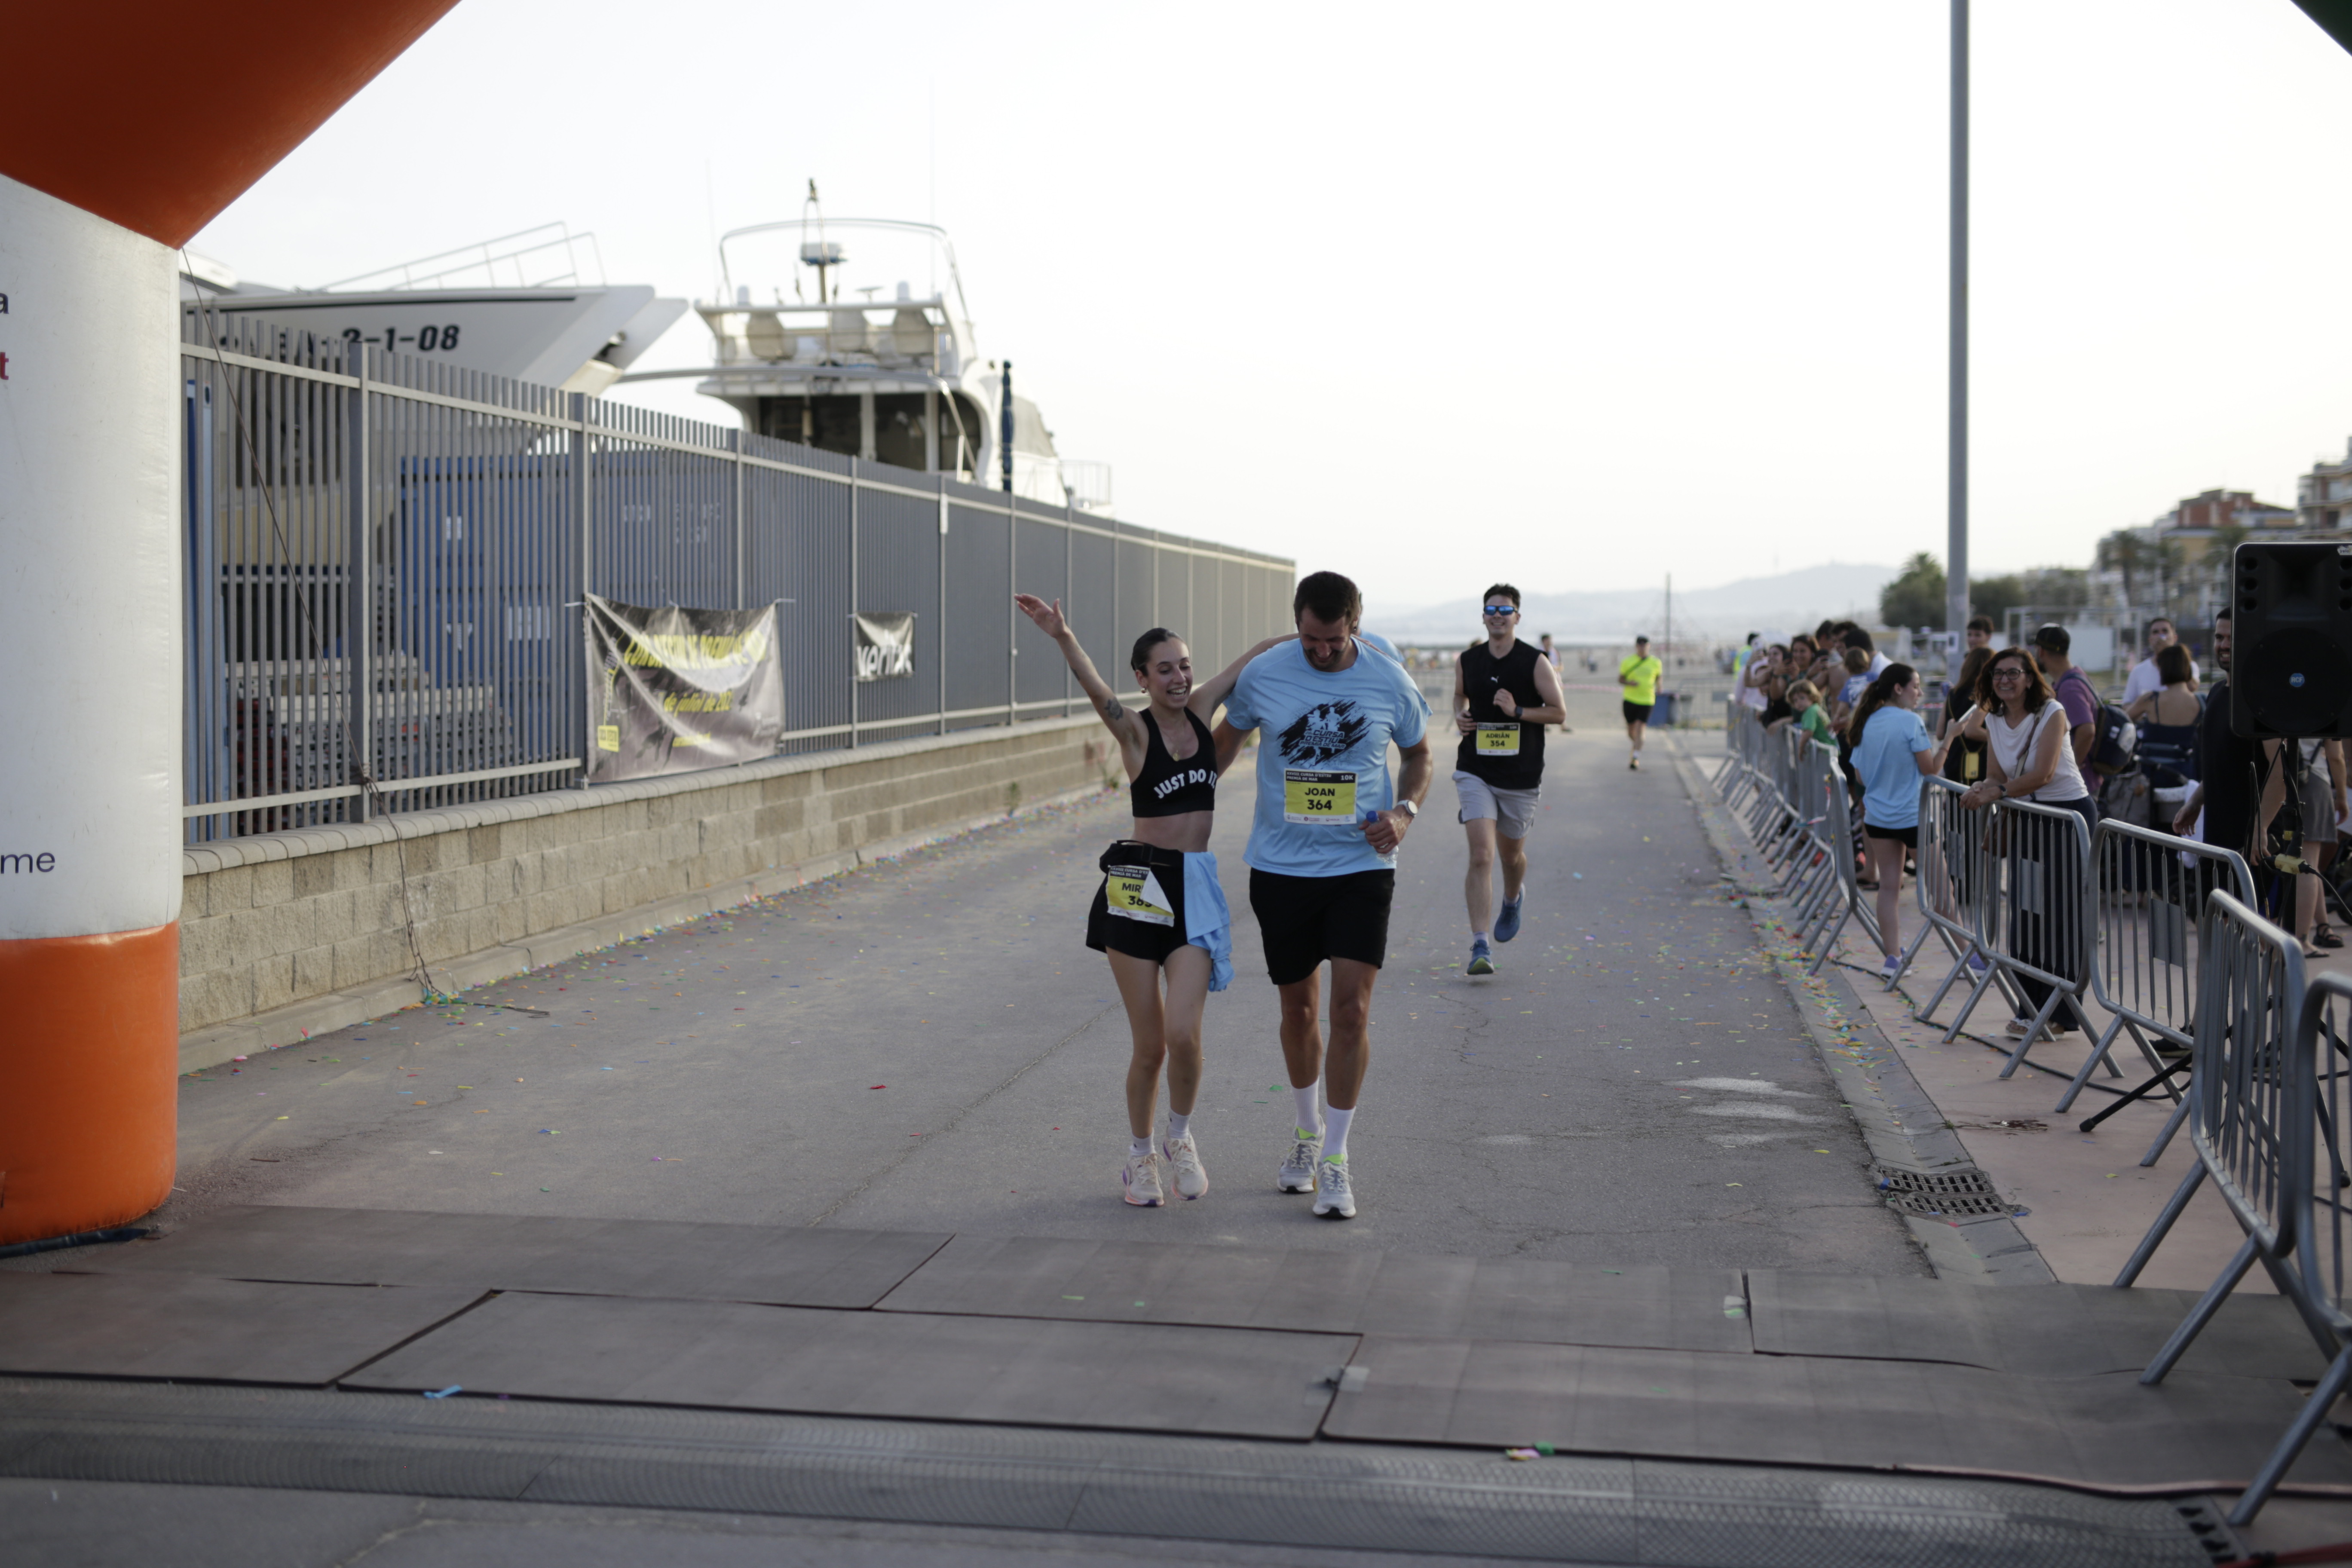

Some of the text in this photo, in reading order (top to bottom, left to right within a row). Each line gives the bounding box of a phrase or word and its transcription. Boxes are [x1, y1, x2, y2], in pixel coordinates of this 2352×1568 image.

[1313, 729, 1344, 738] CURSA
[1154, 773, 1185, 799] JUST
[1188, 769, 1207, 784] DO
[1305, 787, 1335, 796] JOAN
[1307, 799, 1332, 810] 364
[1122, 882, 1144, 893] MIR
